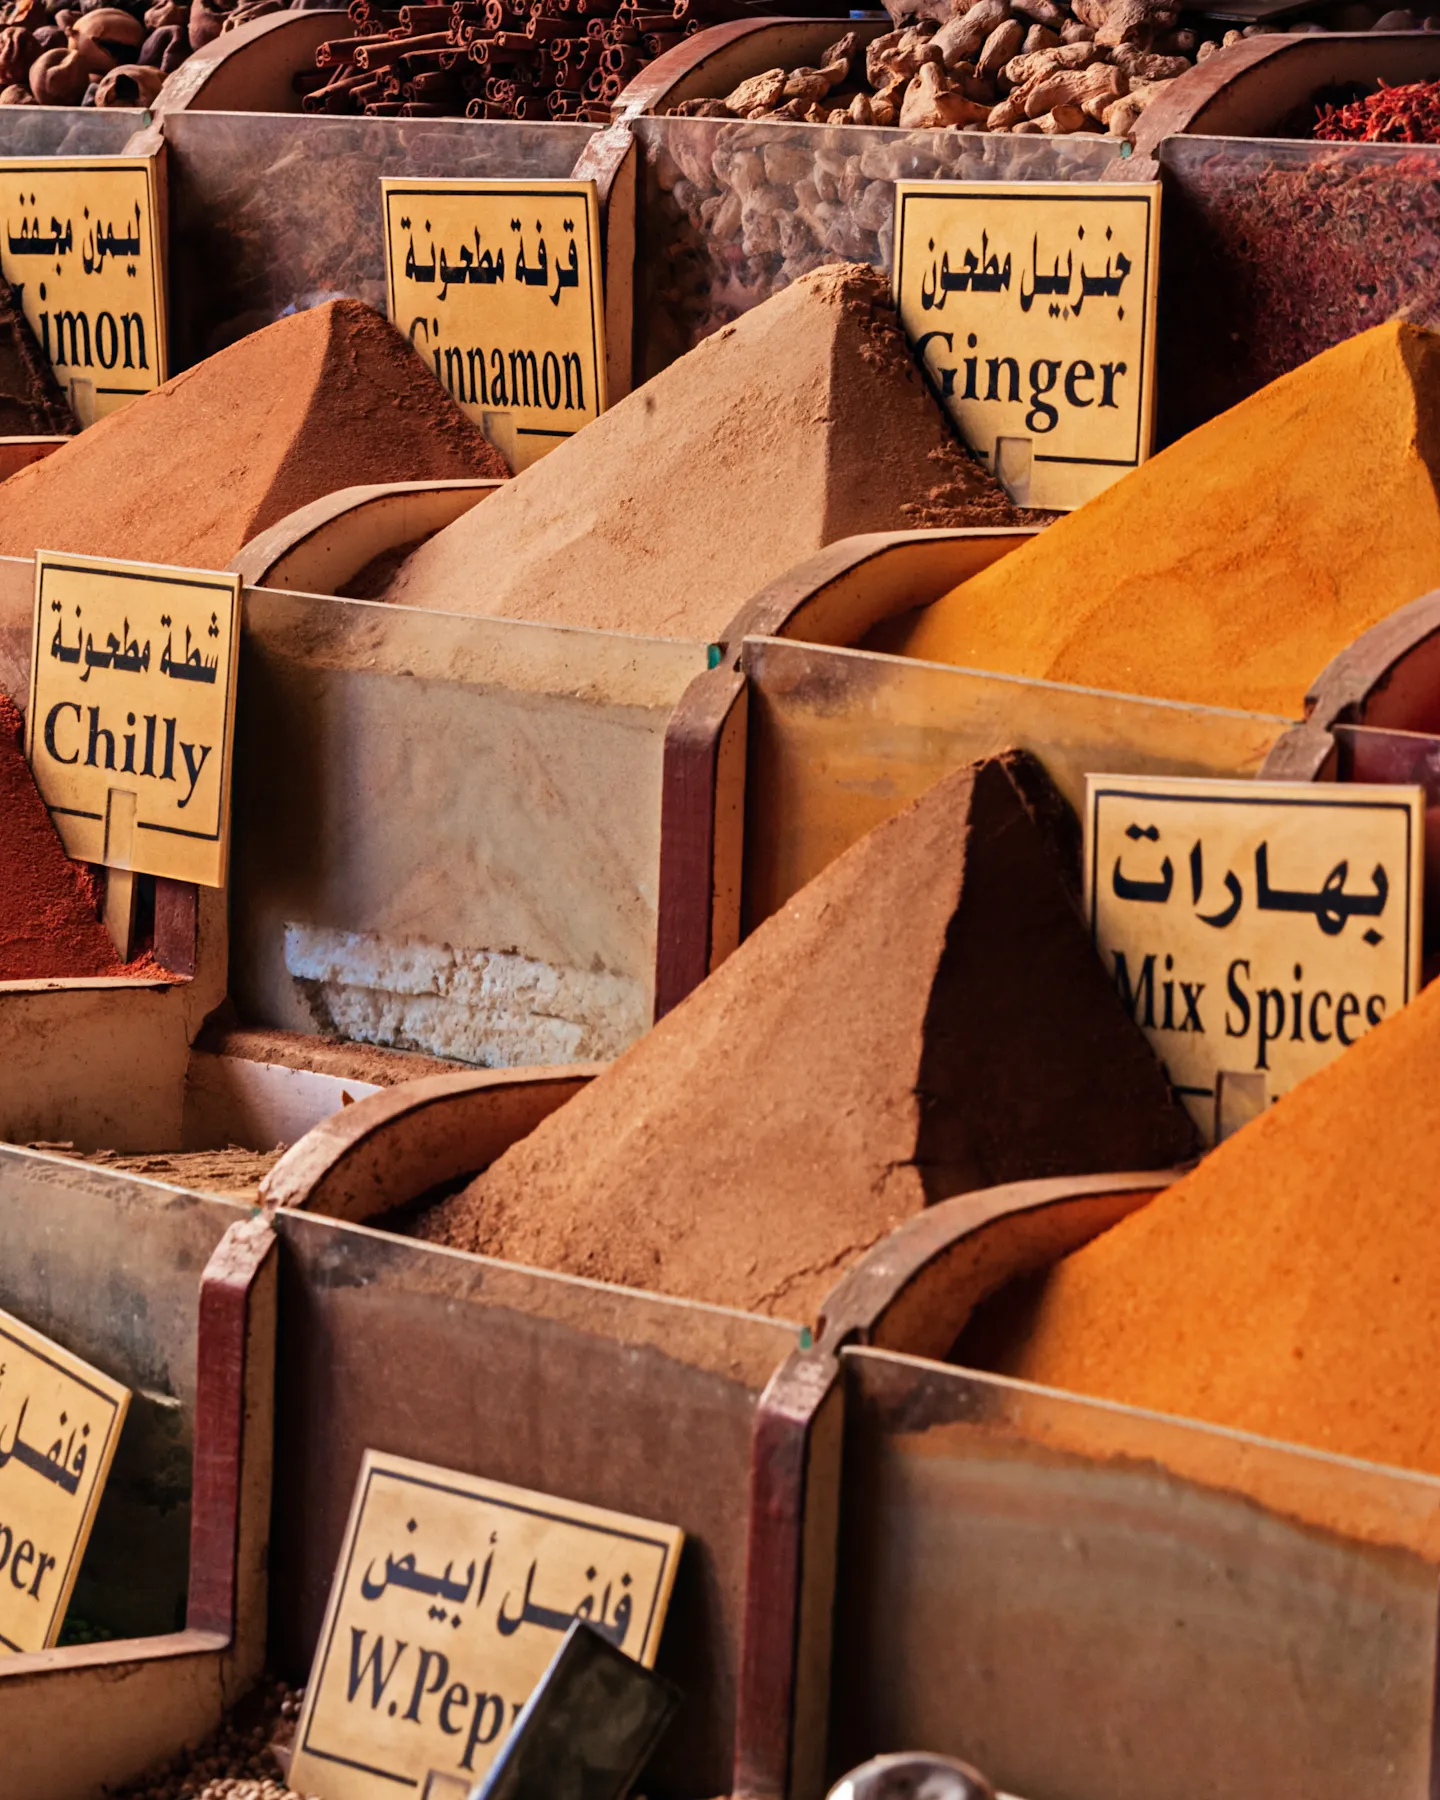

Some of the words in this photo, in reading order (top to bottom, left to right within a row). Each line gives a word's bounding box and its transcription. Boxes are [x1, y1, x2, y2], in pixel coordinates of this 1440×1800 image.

[6, 192, 74, 277] مجفف
[82, 199, 141, 278] ليمون
[400, 216, 505, 302] مطحونة
[510, 217, 580, 307] قرفة
[921, 227, 1012, 311] مطحون
[11, 281, 150, 370] imon
[915, 331, 1128, 434] Ginger
[50, 599, 151, 682] مطحونة
[159, 611, 220, 685] شطة
[44, 701, 213, 809] Chilly
[1112, 822, 1389, 947] بهارات
[1111, 950, 1206, 1034] Mix
[1224, 958, 1387, 1072] Spices
[360, 1517, 498, 1630] أبيض
